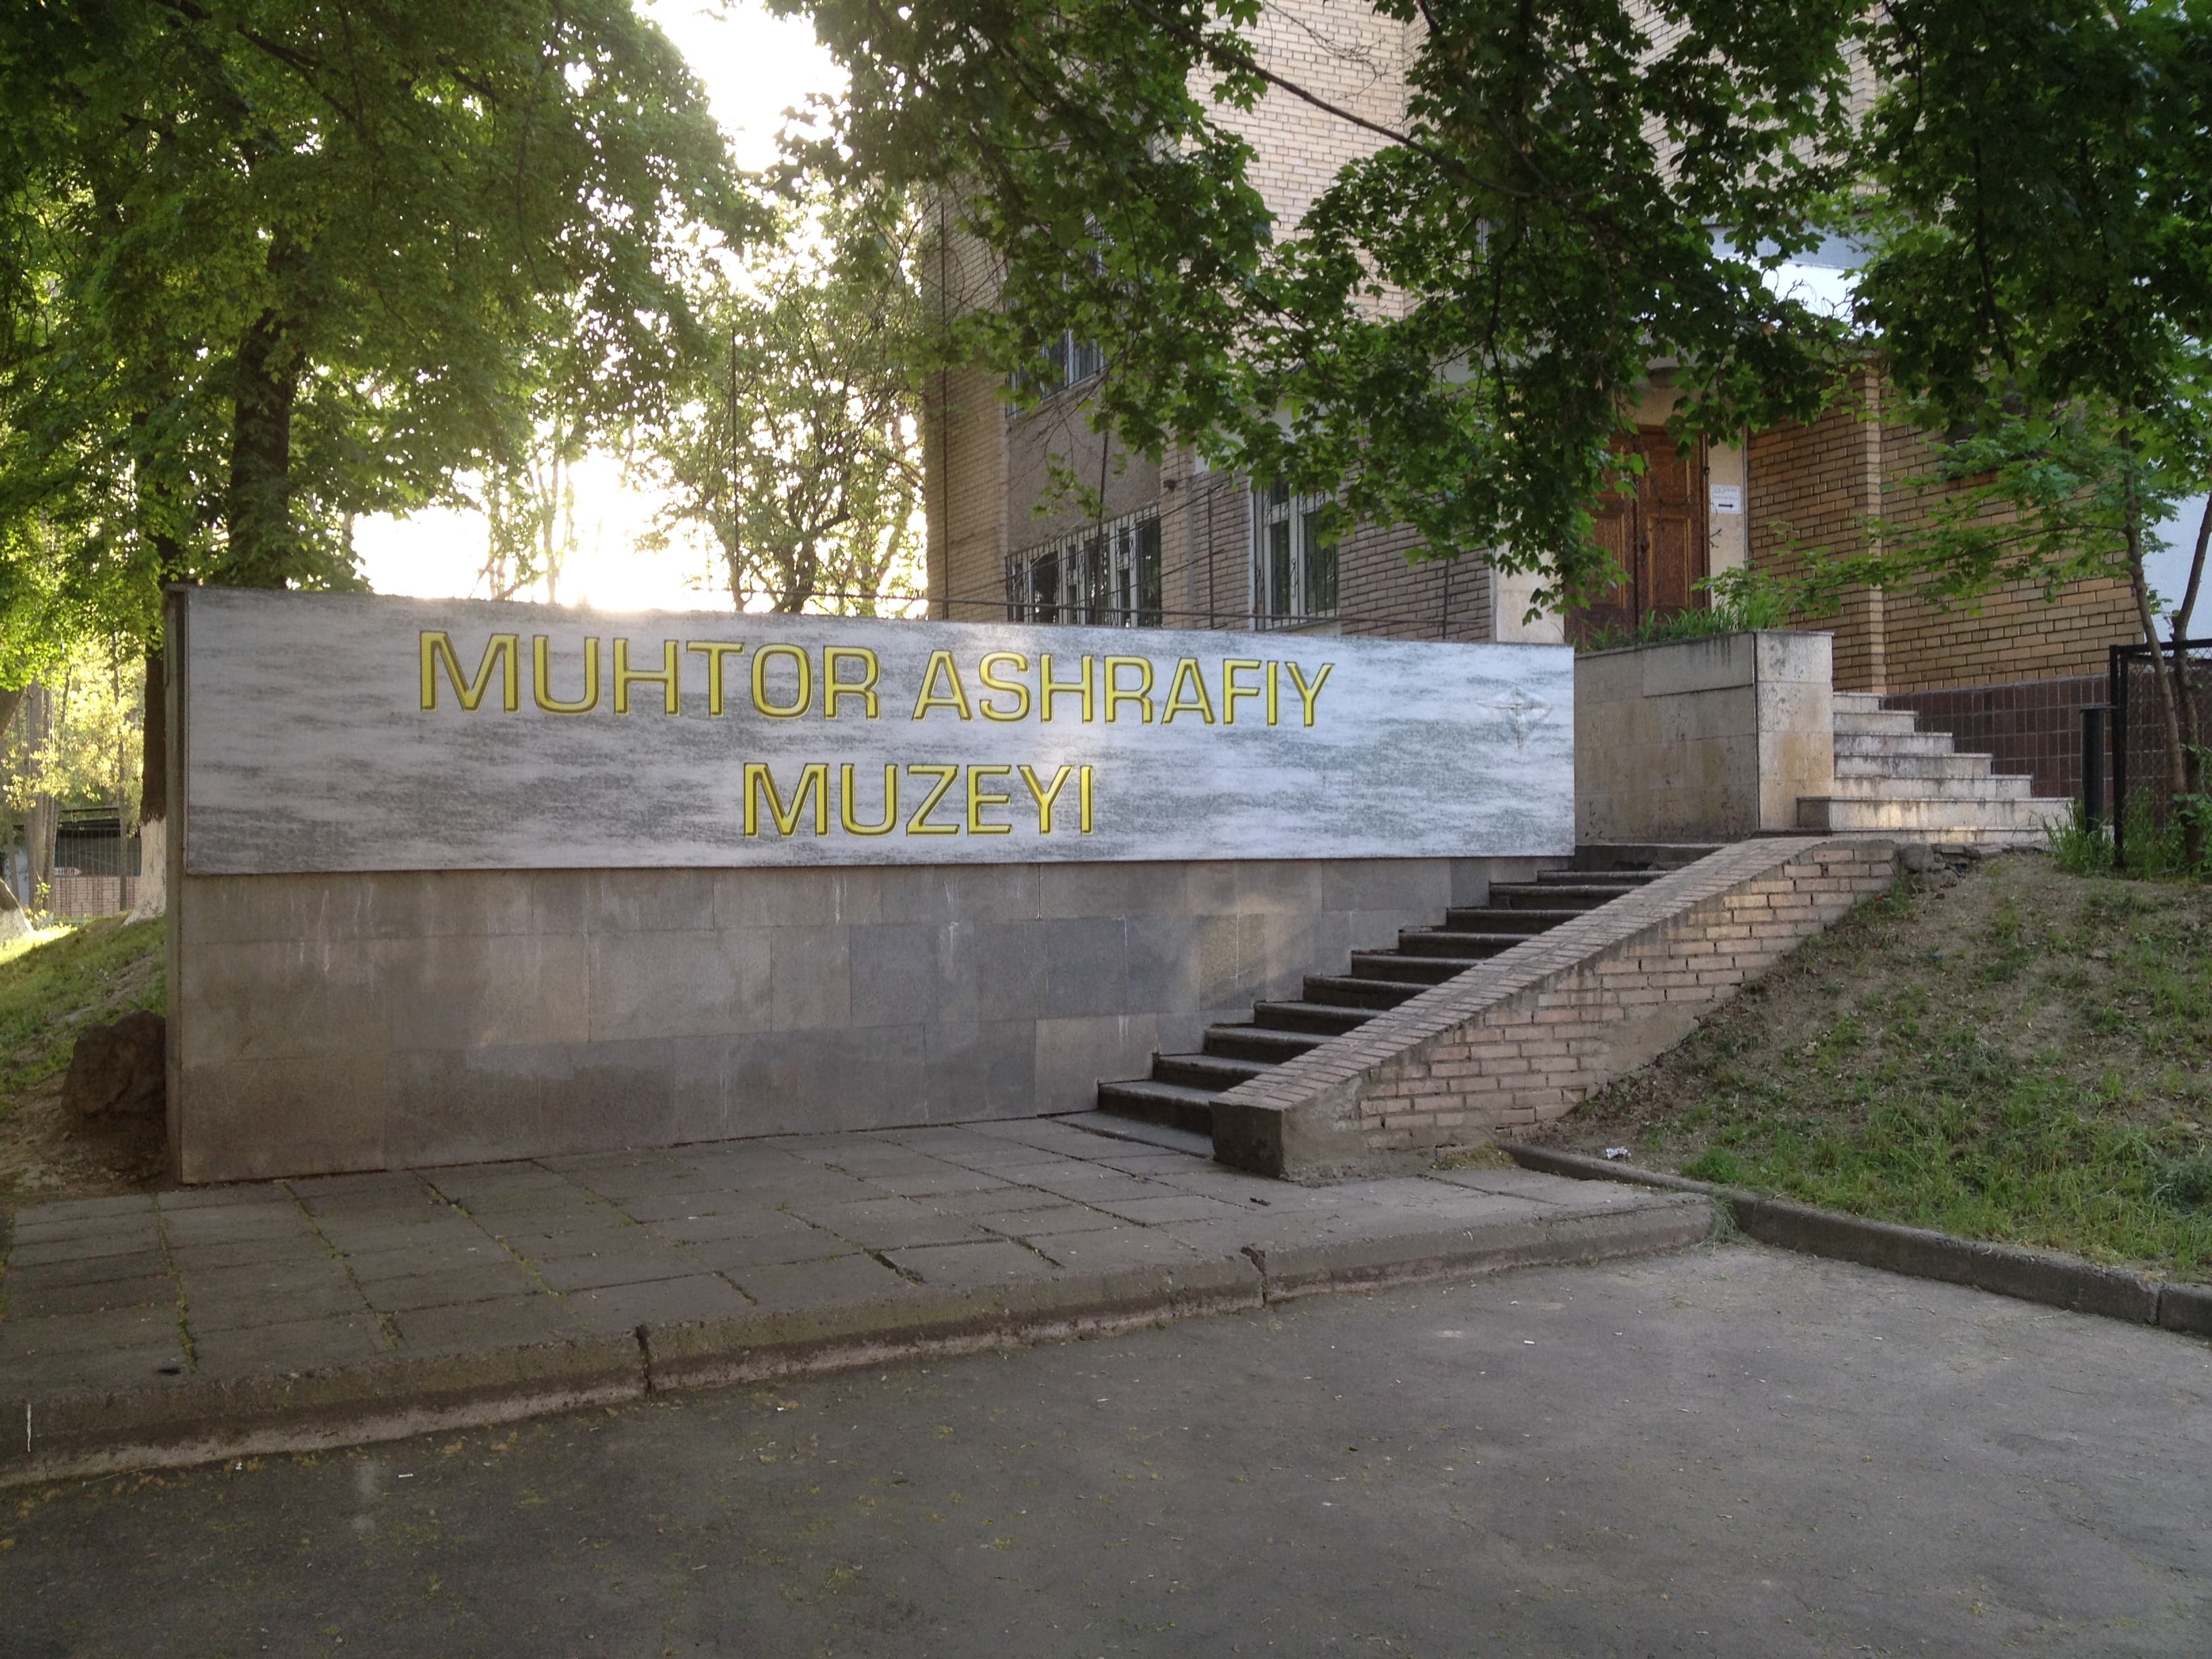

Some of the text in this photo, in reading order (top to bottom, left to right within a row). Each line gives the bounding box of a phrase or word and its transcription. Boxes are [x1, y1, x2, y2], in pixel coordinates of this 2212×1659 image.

[419, 630, 1335, 728] MUHTOR ASHRAFIY
[743, 762, 1094, 838] MUZEYI
